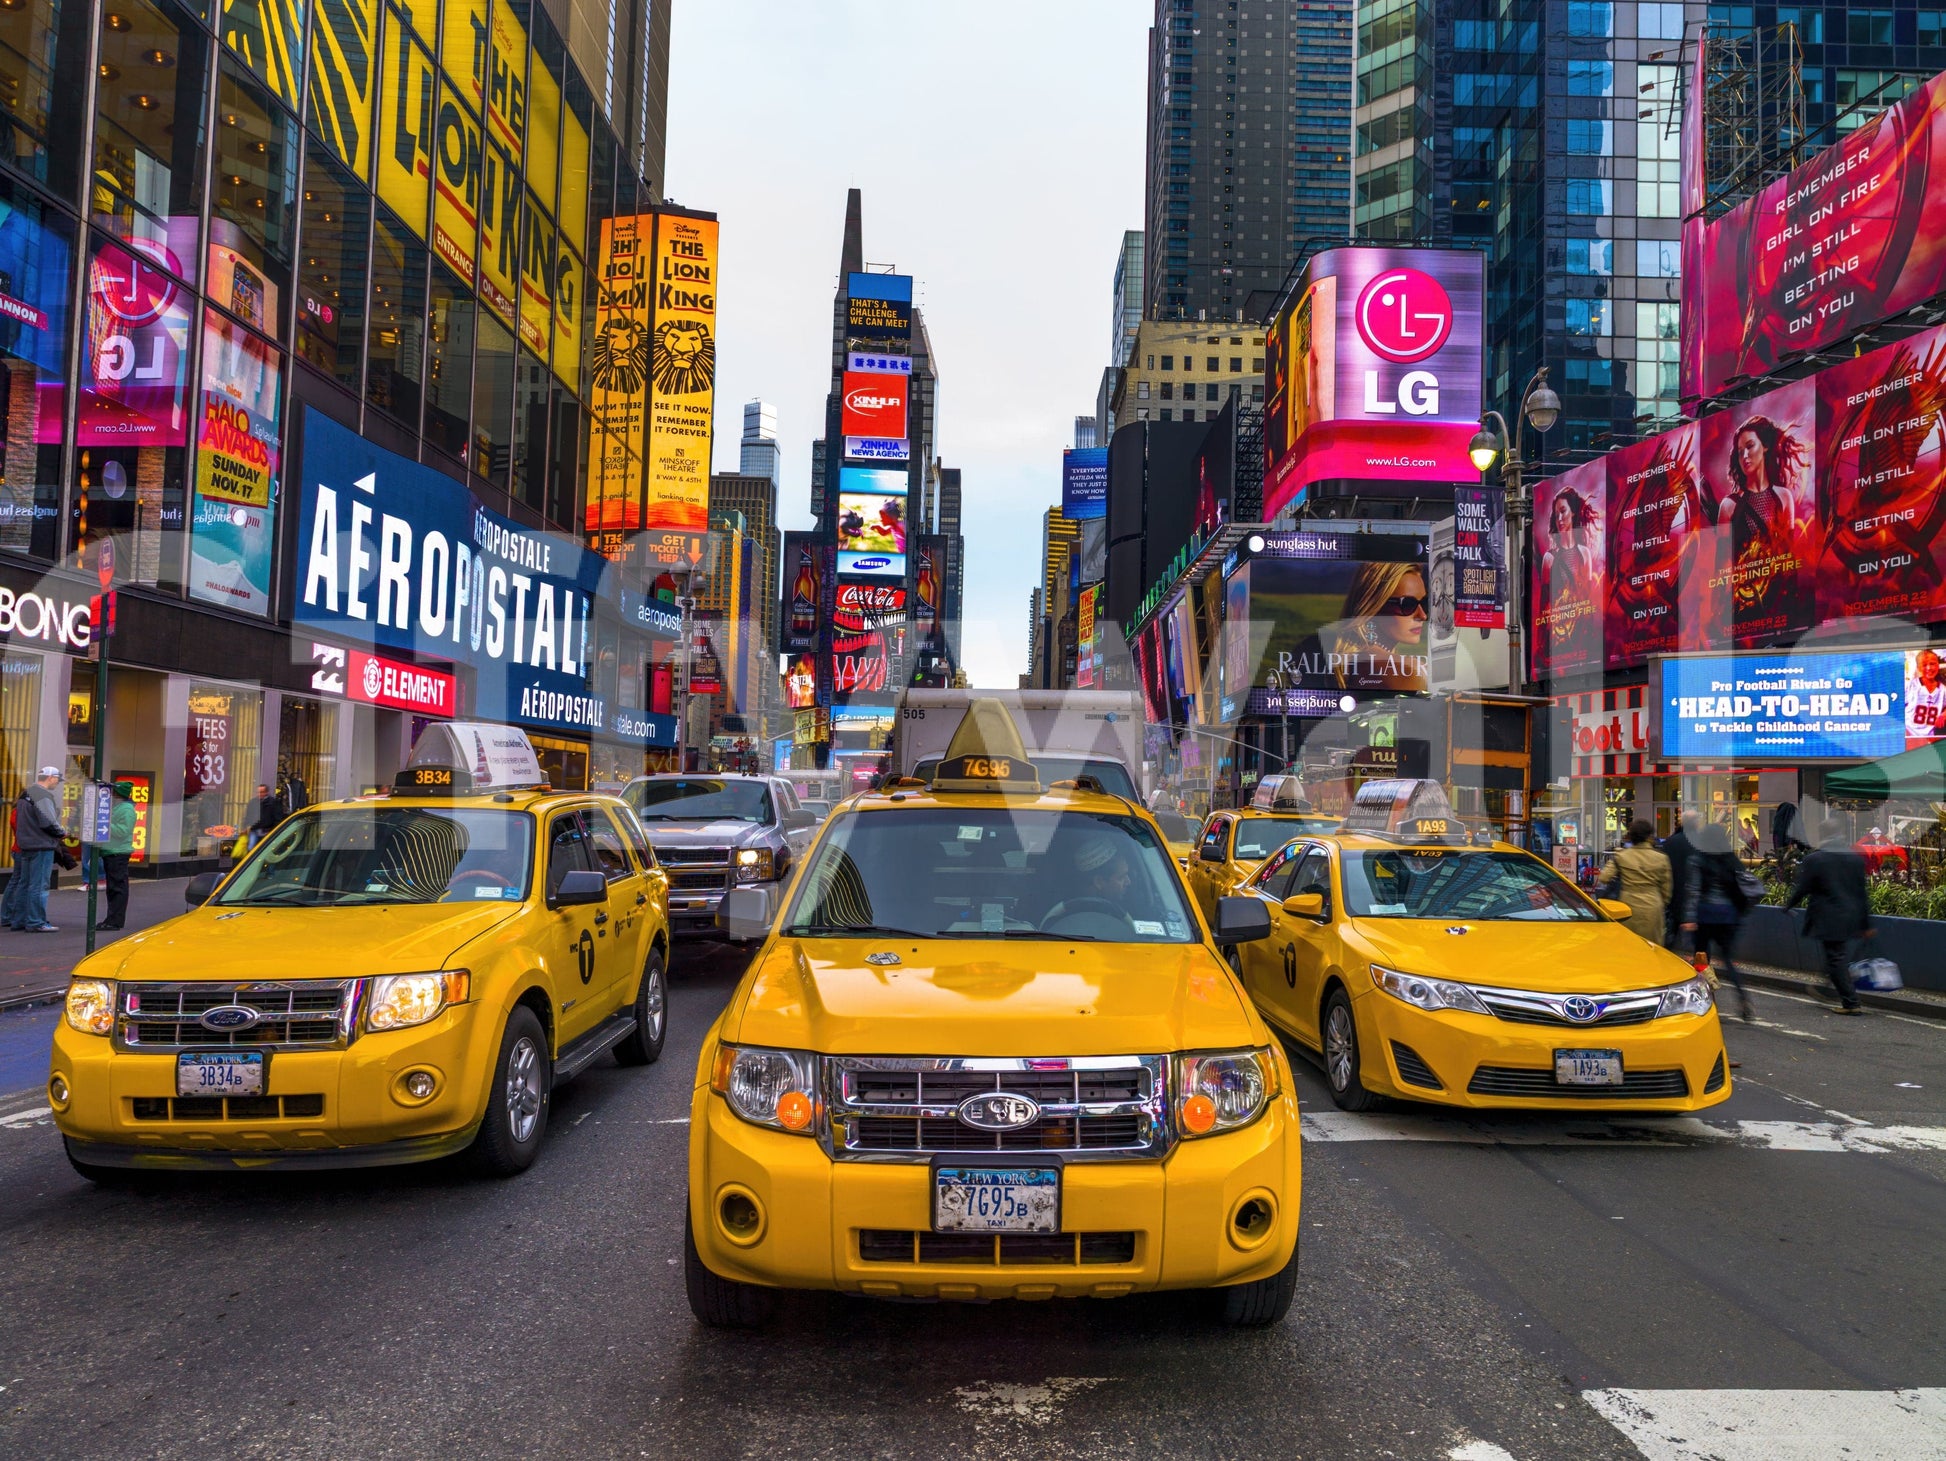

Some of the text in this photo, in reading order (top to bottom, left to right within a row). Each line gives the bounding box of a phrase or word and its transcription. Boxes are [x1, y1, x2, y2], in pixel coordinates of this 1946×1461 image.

[470, 9, 524, 141] THE
[395, 3, 496, 231] LION
[1776, 147, 1870, 215] REMEMBER
[1766, 174, 1881, 251] GIRL ON FIRE
[498, 144, 574, 323] KING
[437, 229, 473, 277] ENTRANCE
[670, 239, 703, 257] THE
[1783, 222, 1861, 273] I'M STILL
[664, 257, 709, 280] LION
[482, 278, 494, 298] ON
[1784, 255, 1860, 304] BETTING
[659, 282, 714, 310] KING
[851, 298, 888, 309] THAT'S A
[850, 307, 897, 319] CHALLENGE
[1788, 291, 1855, 334] ON YOU
[520, 317, 538, 343] STREET
[850, 317, 908, 328] WE CAN MEET
[1364, 370, 1440, 416] LG
[1847, 371, 1923, 407] REMEMBER
[654, 402, 711, 415] SEE IT NOW.
[853, 395, 900, 407] XINHUA
[205, 389, 250, 434] HALO
[656, 416, 706, 428] REMEMBER
[654, 426, 710, 438] IT FOREVER.
[1841, 414, 1929, 451] GIRL ON FIRE
[201, 417, 268, 467] AWARDS
[860, 440, 900, 451] XINHUA
[658, 457, 700, 467] MINSKOFF
[851, 449, 908, 458] NEWS AGENCY
[1366, 457, 1437, 467] www.LG.com
[212, 454, 260, 484] SUNDAY
[663, 465, 696, 474] THEATRE
[1626, 461, 1676, 484] REMEMBER
[1854, 465, 1915, 489] I'M STILL
[211, 472, 253, 499] NOV. 17
[657, 492, 700, 503] lionking.com
[1457, 503, 1487, 518] SOME
[1623, 495, 1680, 520] GIRL ON FIRE
[1457, 517, 1491, 533] WALLS
[1854, 509, 1915, 532] BETTING
[474, 505, 550, 574] AÉROPOSTALE
[662, 534, 686, 545] GET
[1267, 538, 1338, 551] sunglass hut
[1457, 532, 1478, 546] CAN
[1632, 534, 1670, 551] I'M STILL
[1456, 546, 1482, 561] TALK
[1708, 558, 1804, 588] CATCHING FIRE
[1719, 553, 1792, 575] THE HUNGER GAMES
[1858, 554, 1911, 574] ON YOU
[1463, 568, 1497, 582] SPOTLIGHT
[1631, 569, 1670, 586] BETTING
[206, 581, 251, 599] #HALOAWARDS
[1463, 582, 1496, 596] BROADWAY
[1846, 594, 1908, 611] NOVEMBER
[1912, 591, 1929, 601] 22
[1535, 605, 1596, 626] CATCHING FIRE
[1633, 605, 1668, 620] ON YOU
[693, 620, 711, 629] SOME
[693, 628, 714, 638] WALLS
[693, 645, 708, 654] TALK
[1278, 651, 1359, 677] RALPH
[383, 667, 446, 707] ELEMENT
[1711, 679, 1853, 692] Pro Football Rivals Go
[520, 681, 603, 728] AÉROPOSTALE
[1671, 693, 1898, 718] 'HEAD-TO-HEAD'
[903, 708, 926, 720] 505
[1913, 704, 1938, 726] 88
[195, 717, 227, 740] TEES
[1694, 720, 1872, 734] to Tackle Childhood Cancer
[201, 741, 218, 753] 3 for
[193, 754, 225, 785] $33
[415, 770, 451, 784] 3B34
[963, 758, 1011, 778] 7G95
[1415, 819, 1448, 833] 1A93
[213, 1012, 241, 1026] Ford
[200, 1056, 243, 1065] NEW YORK
[996, 1173, 1028, 1186] YORK
[986, 1219, 1007, 1227] TAXI
